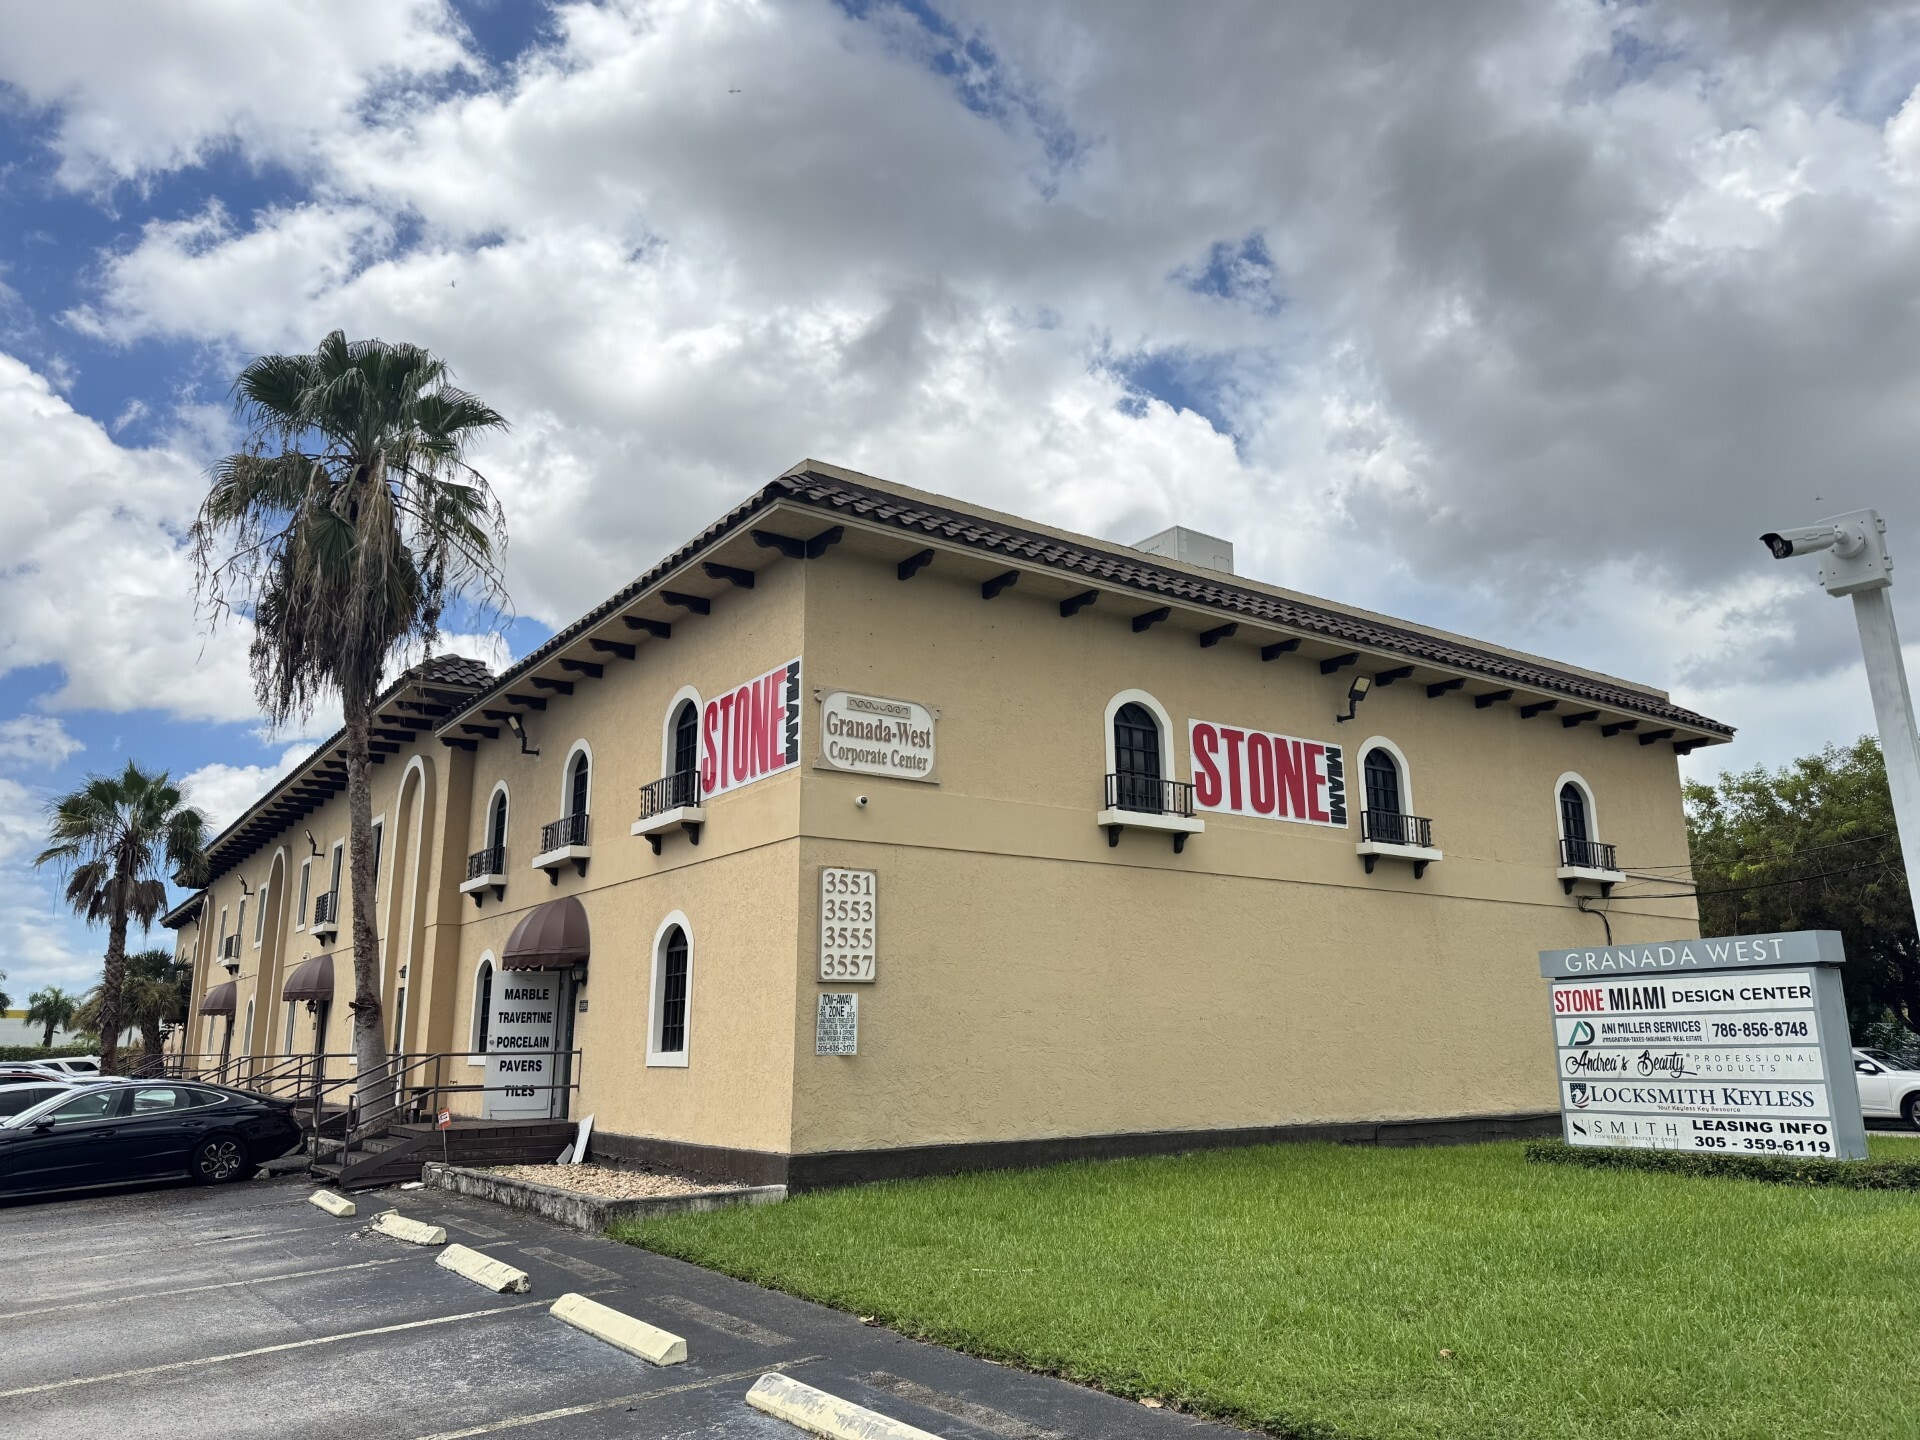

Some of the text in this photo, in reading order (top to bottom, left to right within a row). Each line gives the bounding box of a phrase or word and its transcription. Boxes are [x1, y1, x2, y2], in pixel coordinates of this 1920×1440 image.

[785, 661, 800, 764] MIAMI
[702, 668, 786, 793] STONE
[826, 710, 931, 749] Granada-West
[829, 741, 928, 771] Corporate Center
[1193, 723, 1329, 822] STONE
[1325, 746, 1347, 824] MIAMI
[825, 872, 872, 896] 3551
[824, 899, 873, 922] 3553
[823, 926, 873, 950] 3555
[823, 953, 873, 977] 3557
[1565, 938, 1784, 972] GRANADA WEST
[504, 988, 550, 1000] MARBLE
[1554, 985, 1811, 1013] STONE MIAMI DESIGN CENTER
[498, 1011, 552, 1024] TRAVERTINE
[828, 1006, 845, 1017] ZONE
[1601, 1020, 1702, 1034] ANI MILLER SERVICES
[1711, 1021, 1808, 1038] 786-856-8748
[496, 1036, 550, 1048] PORCELAIN
[499, 1060, 543, 1072] PAVERS
[1637, 1049, 1698, 1078] Beauty
[1694, 1054, 1815, 1063] PROFESSIONAL
[1696, 1064, 1776, 1072] PRODUCTS
[505, 1085, 535, 1097] TILES
[1590, 1085, 1815, 1108] LOCKSMITH KEYLESS
[1594, 1120, 1678, 1136] SMITH
[1691, 1120, 1828, 1135] LEASING INFO
[1694, 1136, 1726, 1148] 305
[1743, 1138, 1831, 1153] 359-6119
